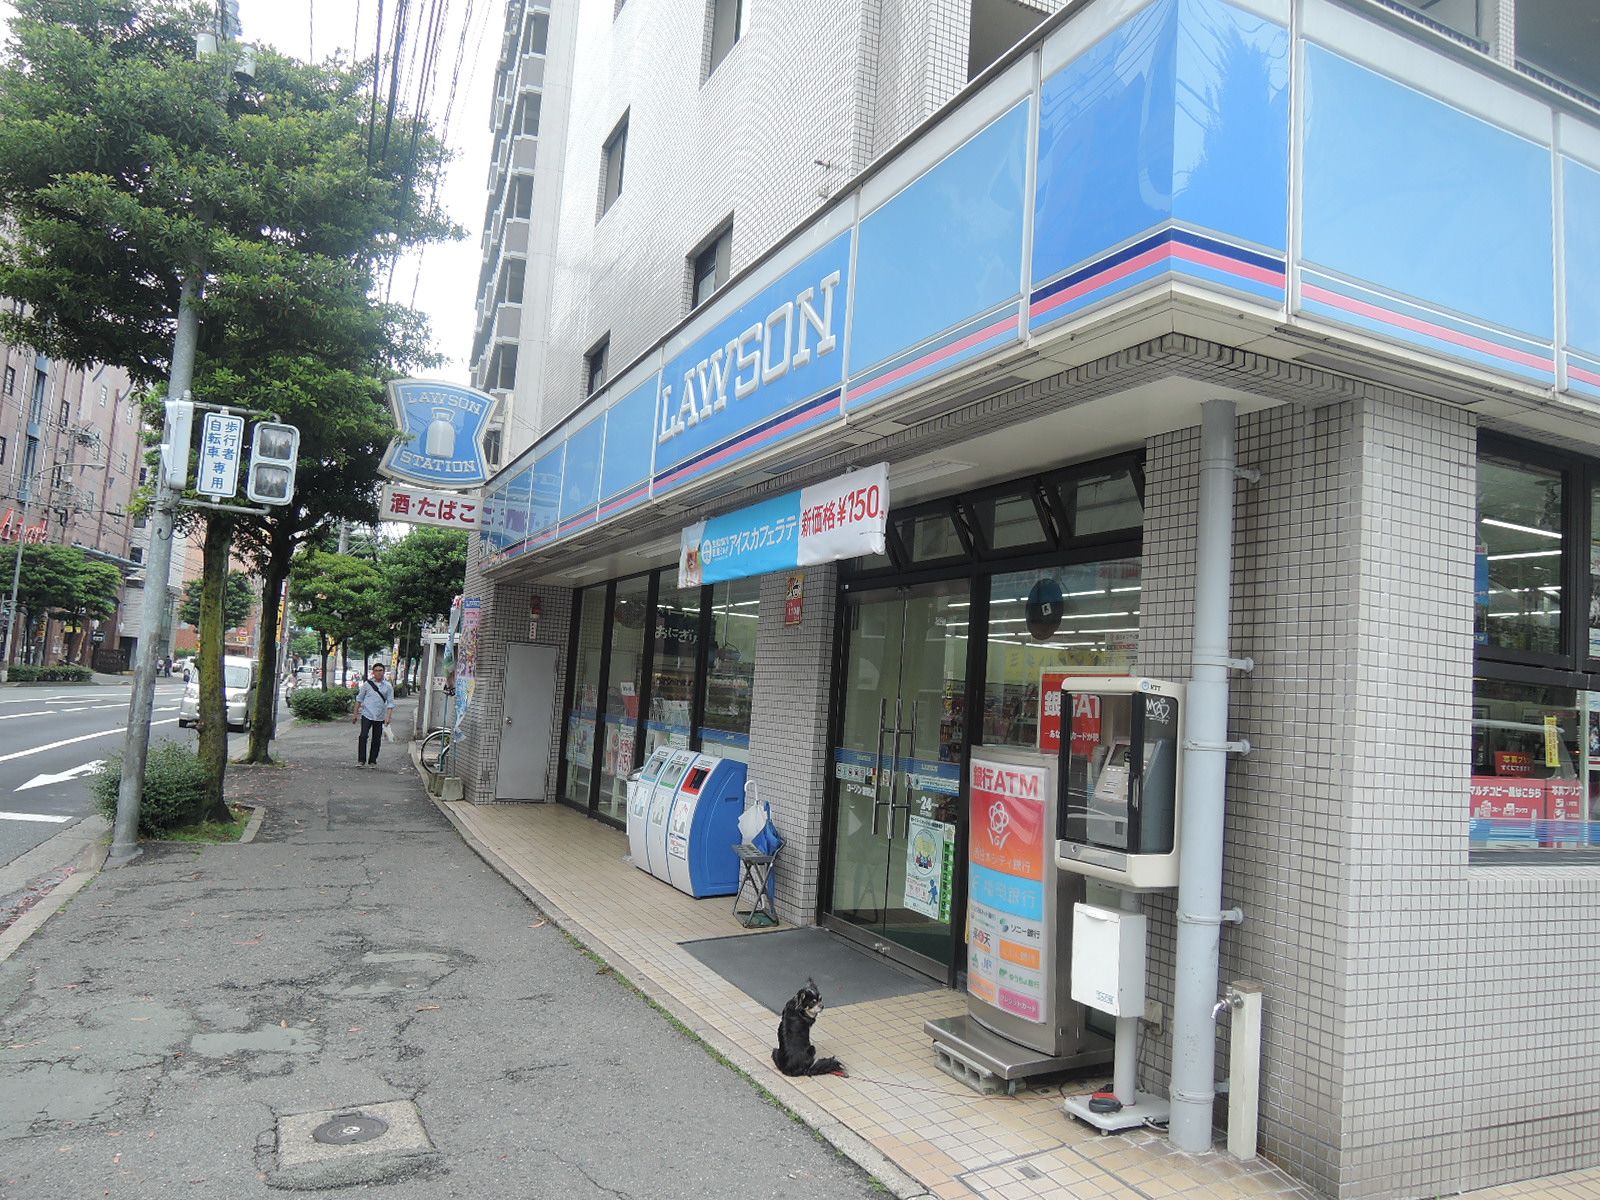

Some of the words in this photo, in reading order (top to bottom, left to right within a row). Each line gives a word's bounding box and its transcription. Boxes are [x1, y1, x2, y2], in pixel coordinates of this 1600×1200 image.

[659, 270, 840, 444] LAWSON
[406, 391, 483, 416] LAWSON
[206, 419, 222, 458] 自転車
[222, 421, 238, 461] 歩行者
[210, 462, 226, 490] 専用
[400, 451, 477, 474] STATION
[728, 514, 798, 557] アイスカフェラテ
[655, 624, 698, 645] おにぎり
[973, 765, 1039, 798] 銀行ATM
[1010, 923, 1041, 941] ソニー銀行
